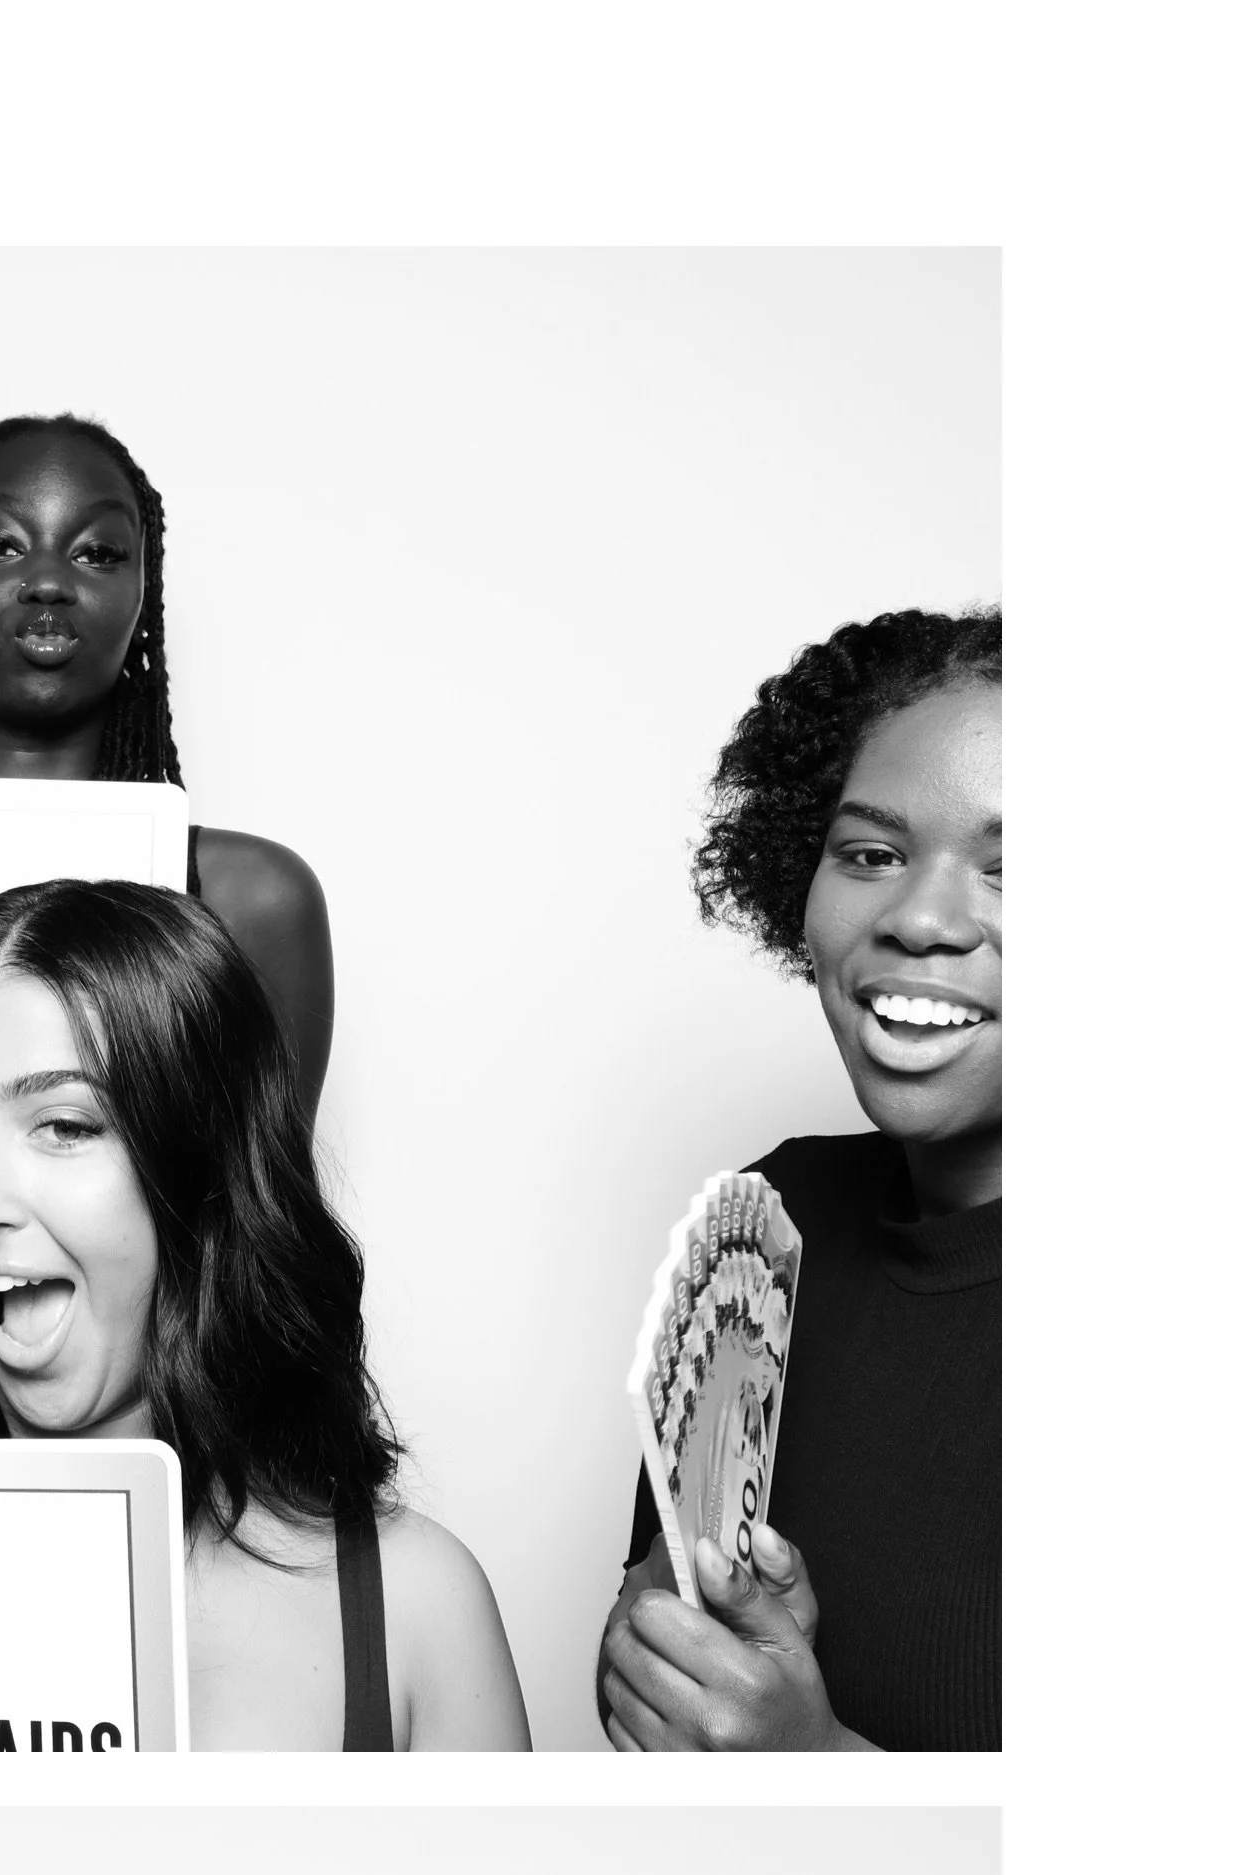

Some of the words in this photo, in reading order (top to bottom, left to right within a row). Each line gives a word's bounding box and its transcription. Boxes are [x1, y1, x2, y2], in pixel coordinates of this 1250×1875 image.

[709, 1219, 719, 1259] 100
[692, 1243, 703, 1286] 100
[736, 1478, 757, 1562] 00
